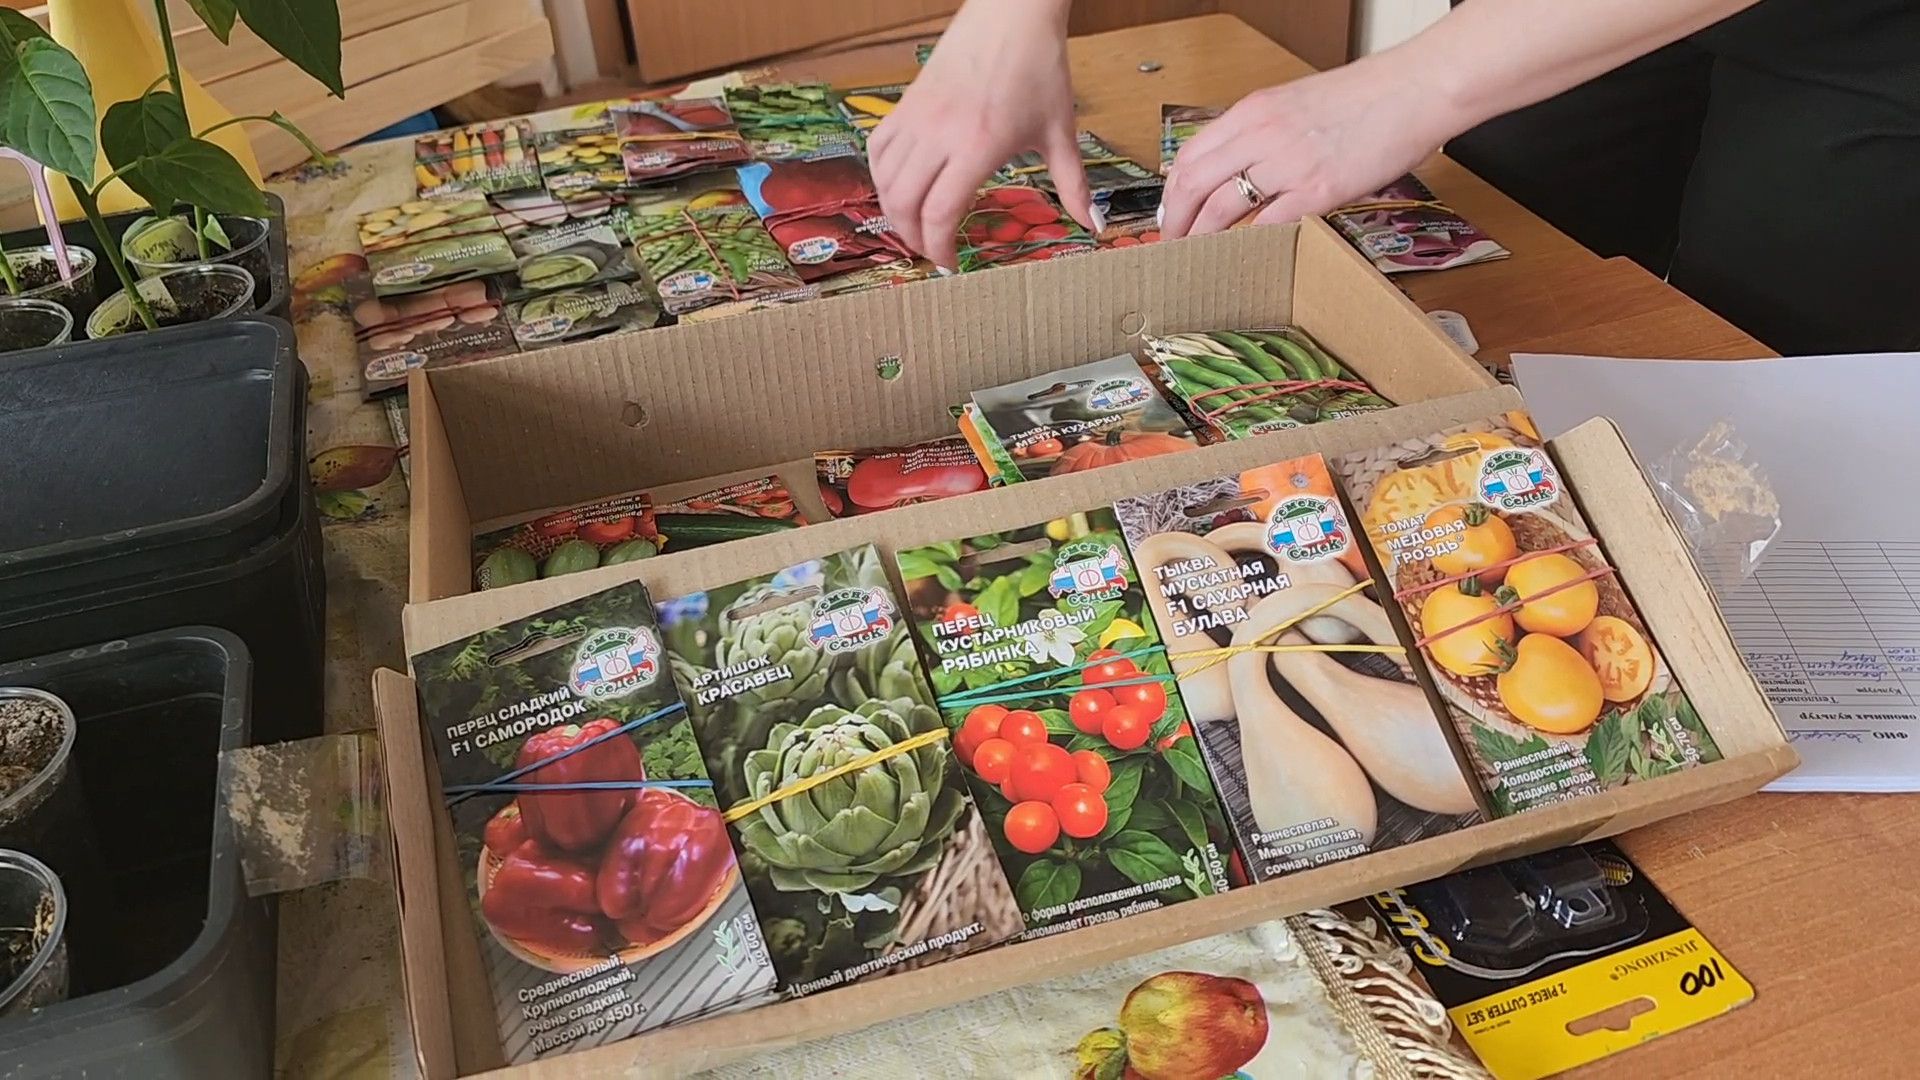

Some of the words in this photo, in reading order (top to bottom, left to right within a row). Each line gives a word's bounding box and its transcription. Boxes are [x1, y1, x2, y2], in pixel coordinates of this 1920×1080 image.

[1010, 425, 1051, 440] ТЫКВА
[1015, 431, 1061, 448] МЕЧТА
[1061, 414, 1122, 434] КУХАРКИ
[1379, 513, 1426, 535] ТОМАТ
[1386, 519, 1467, 551] МЕДОВАЯ
[1153, 556, 1217, 580] ТЫКВА
[1160, 560, 1265, 598] МУСКАТНАЯ
[1166, 600, 1189, 617] F1
[1192, 574, 1292, 611] САХАРНАЯ
[931, 612, 995, 638] ПЕРЕЦ
[936, 605, 1097, 655] КУСТАРНИКОВЫЙ
[1172, 606, 1250, 637] БУЛАВА
[693, 654, 771, 689] АРТИШОК
[942, 640, 1039, 674] РЯБИНКА
[697, 665, 793, 706] КРАСАВЕЦ
[1767, 696, 1838, 705] Теплолюби
[447, 714, 499, 740] ПЕРЕЦ
[499, 686, 571, 721] СЛАДКИЙ
[451, 741, 471, 757] F1
[475, 700, 587, 748] САМОРОДОК
[1799, 712, 1853, 721] культур
[1493, 741, 1575, 773] Раннеспелый.
[1500, 753, 1592, 790] Холодостойкий.
[1509, 780, 1558, 804] Сладкие
[1558, 769, 1597, 790] плоды
[1251, 816, 1339, 845] Раннеспелая.
[1257, 842, 1305, 861] Мякоть
[1305, 827, 1363, 850] плотная,
[1206, 842, 1219, 859] см
[1265, 856, 1315, 876] сочная,
[1314, 843, 1371, 864] сладкая.
[1031, 903, 1067, 924] форме
[1067, 884, 1143, 914] расположения
[1143, 874, 1182, 894] плодов
[1083, 909, 1119, 928] гроздь
[1120, 898, 1164, 919] рябины.
[741, 913, 754, 931] см
[746, 932, 760, 949] 60
[754, 950, 769, 967] до
[789, 966, 843, 998] Ценный
[844, 940, 929, 982] диетический
[928, 921, 985, 951] продукт.
[518, 954, 624, 1002] Среднеспелый.
[1557, 981, 1568, 996] 2
[1680, 957, 1726, 997] 100
[522, 969, 637, 1019] Крупноплодный,
[1486, 995, 1528, 1021] CUTTER
[1527, 983, 1558, 1008] PIECE
[528, 1011, 568, 1037] очень
[568, 989, 630, 1019] сладкий.
[531, 1024, 586, 1054] Массой
[586, 1016, 605, 1034] до
[607, 1005, 634, 1025] 450
[1465, 1008, 1487, 1027] SET
